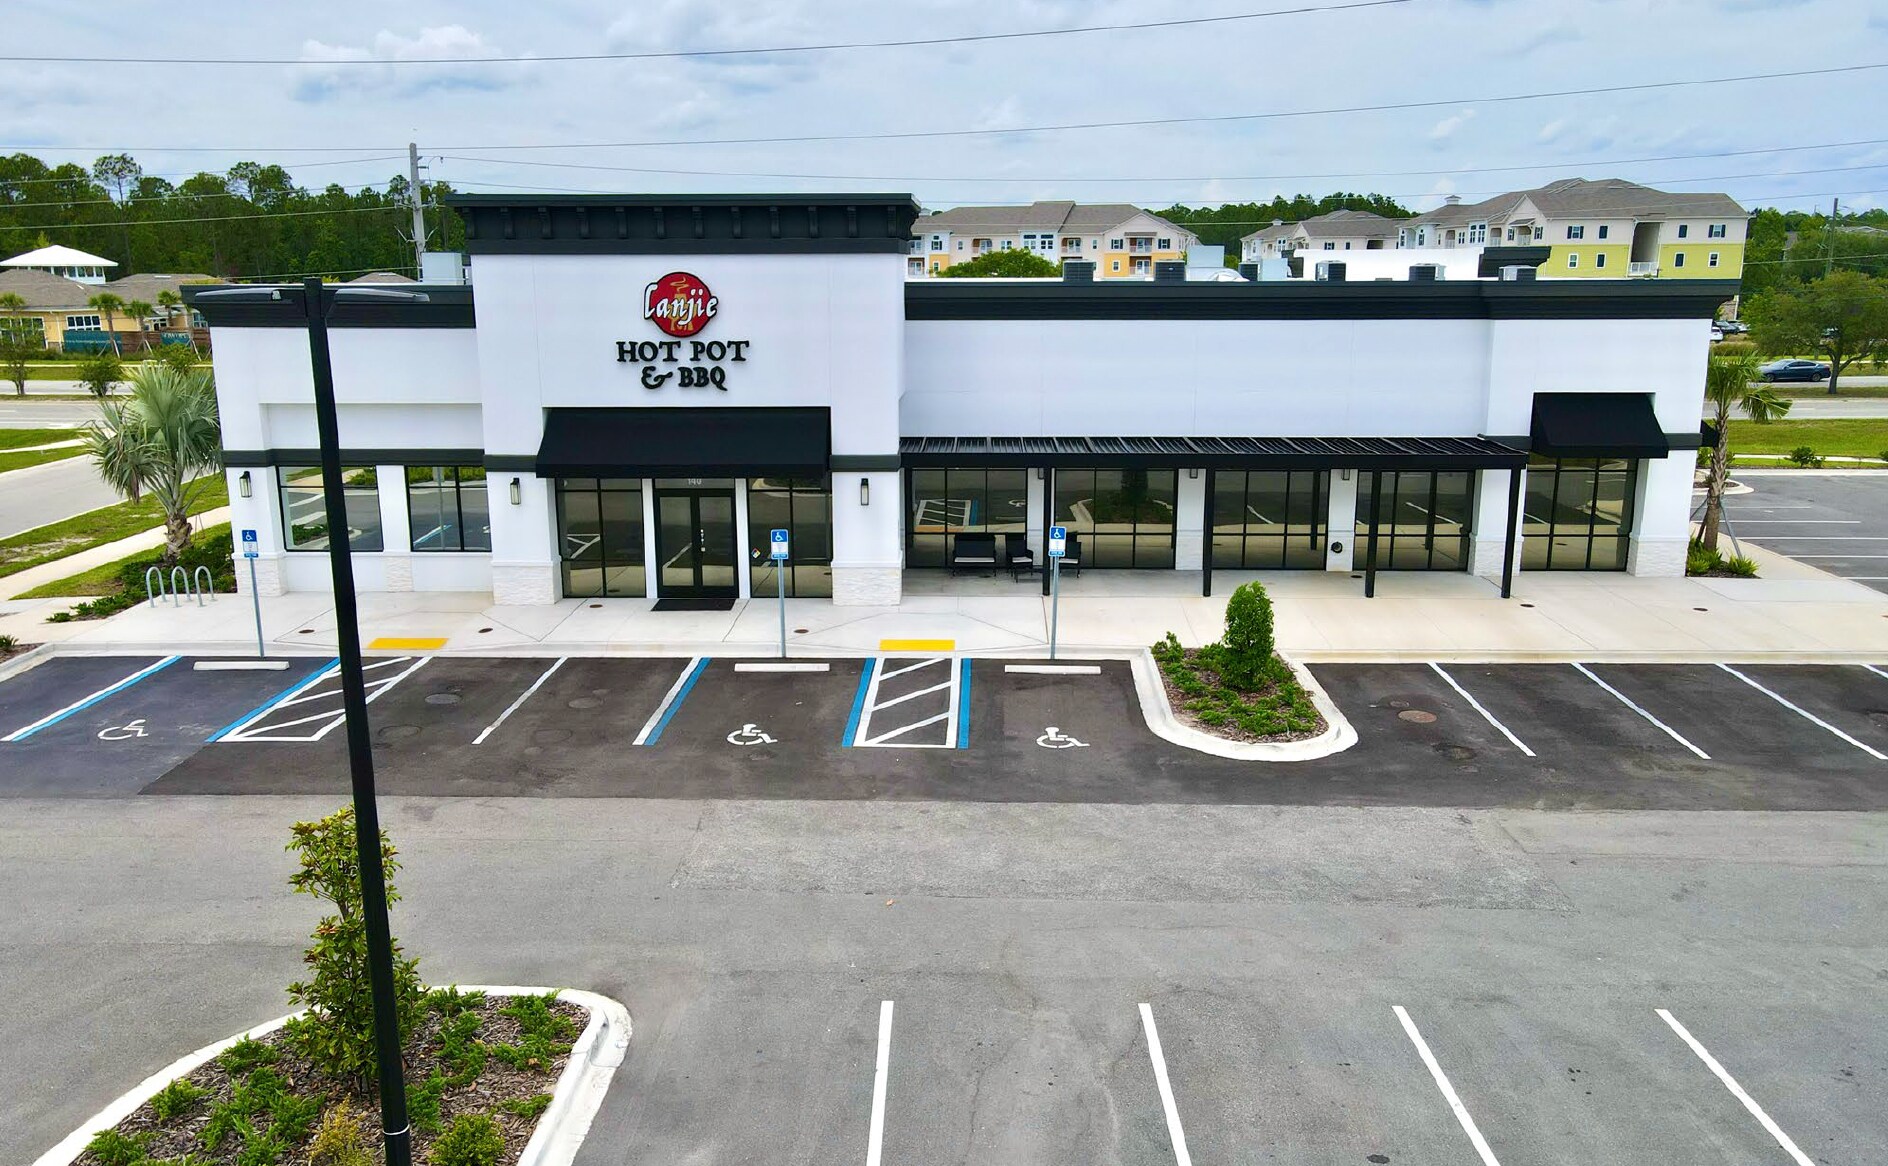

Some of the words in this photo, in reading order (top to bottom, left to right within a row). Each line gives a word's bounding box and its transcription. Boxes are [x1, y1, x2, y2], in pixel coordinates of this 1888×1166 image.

[644, 283, 718, 325] Lanjie
[616, 341, 681, 362] HOT
[690, 340, 749, 361] POT
[641, 366, 673, 389] &
[677, 366, 728, 391] BBQ
